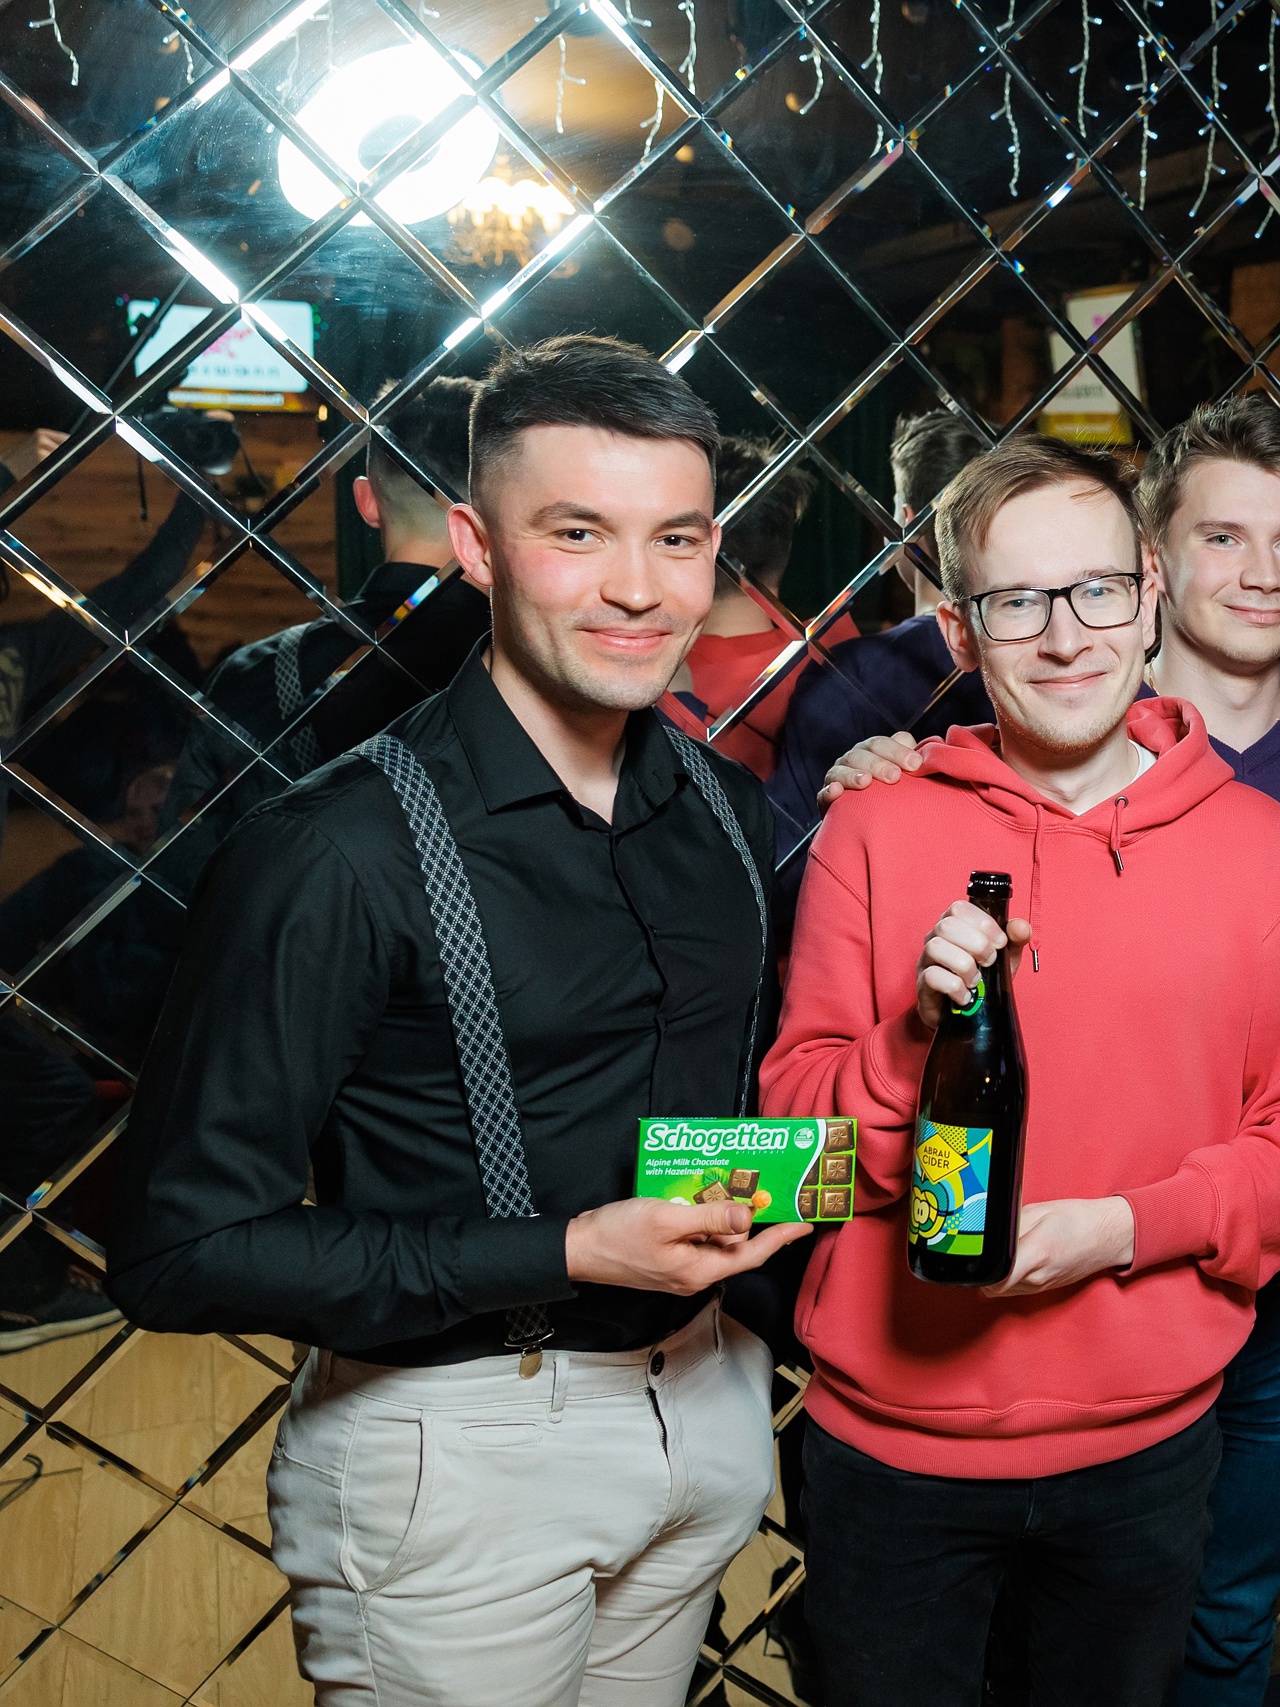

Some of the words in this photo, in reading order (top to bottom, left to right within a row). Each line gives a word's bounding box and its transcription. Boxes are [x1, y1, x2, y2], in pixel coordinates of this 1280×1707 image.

[645, 1123, 789, 1156] Schogetten
[923, 1145, 950, 1159] ABRAU
[646, 1158, 671, 1167] Alpine
[673, 1158, 690, 1166] Milk
[691, 1158, 730, 1166] Chocolate
[922, 1154, 950, 1169] CIDER
[646, 1167, 663, 1175] with
[665, 1167, 704, 1175] Hazelnuts
